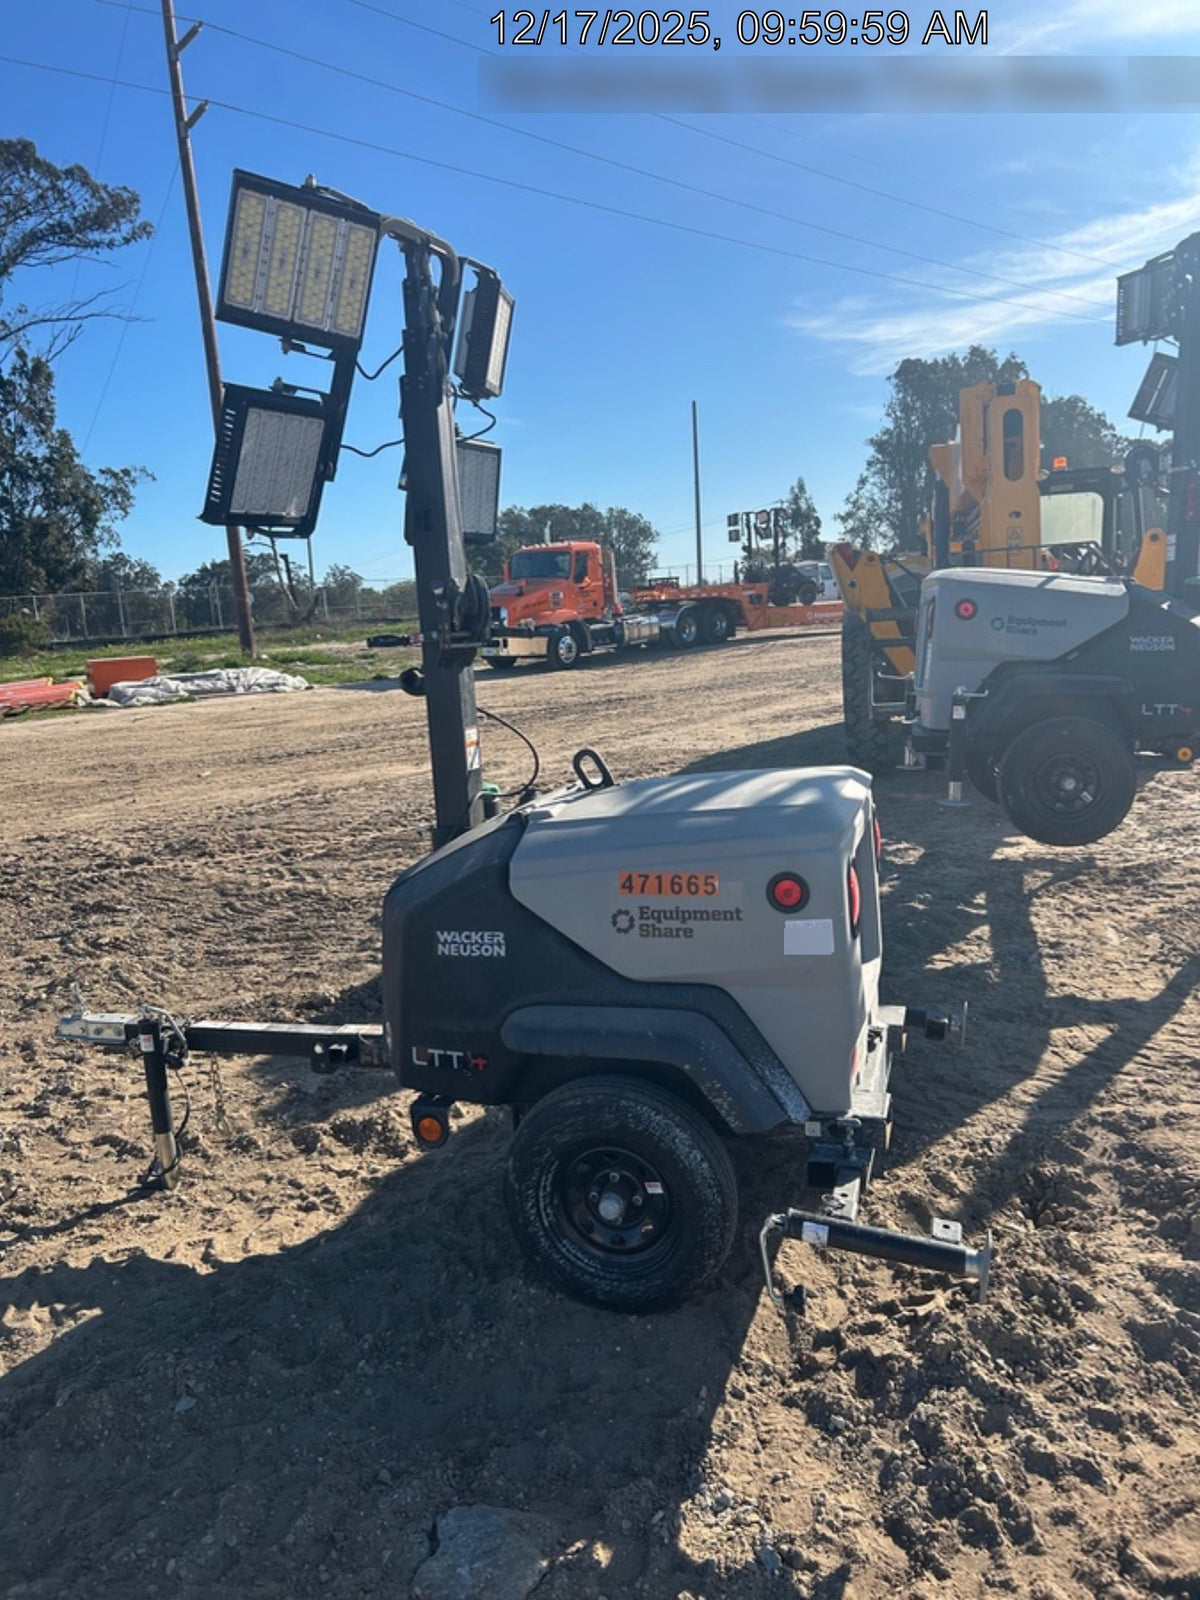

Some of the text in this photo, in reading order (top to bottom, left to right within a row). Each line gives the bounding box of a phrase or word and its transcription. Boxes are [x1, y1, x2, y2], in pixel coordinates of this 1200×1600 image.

[621, 873, 717, 896] 471665
[638, 906, 744, 924] Equipment
[436, 931, 505, 944] WACKER
[638, 923, 694, 939] Share
[438, 943, 506, 957] NEUSON
